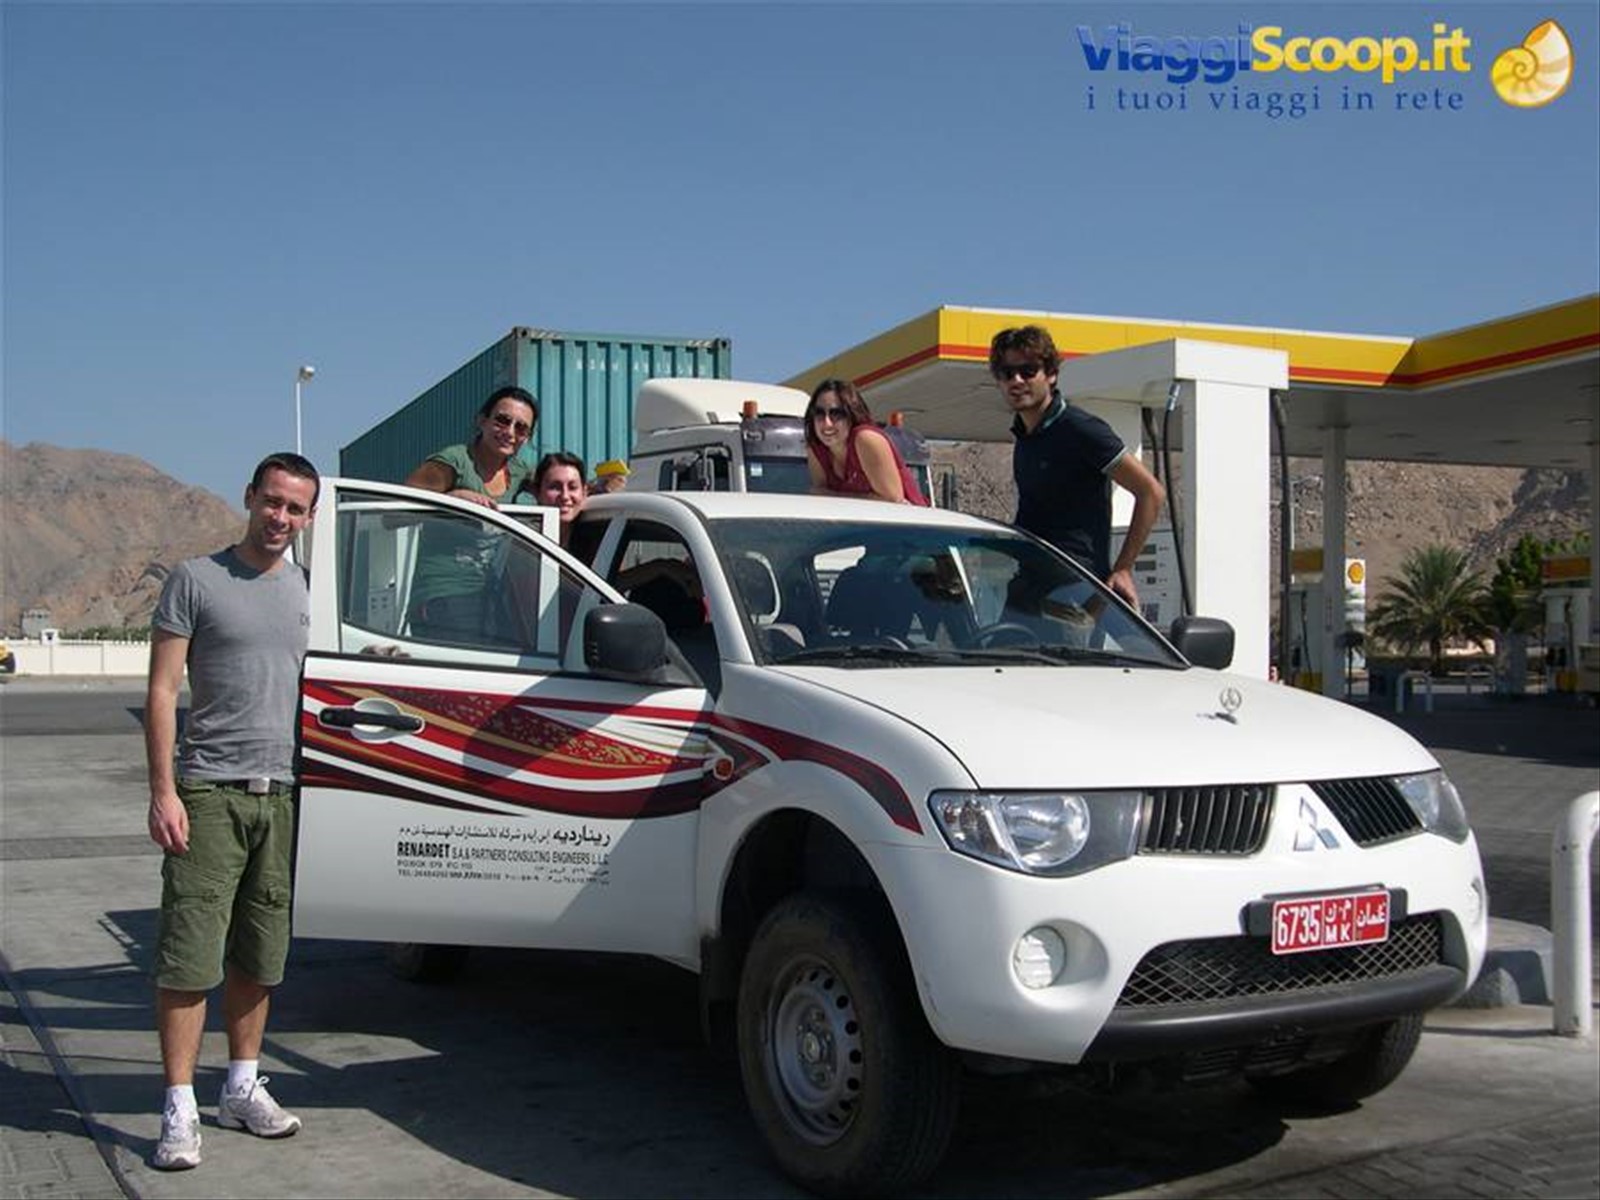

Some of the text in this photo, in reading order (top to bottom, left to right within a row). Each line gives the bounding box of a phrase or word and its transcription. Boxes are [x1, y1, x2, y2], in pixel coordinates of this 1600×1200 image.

[397, 841, 450, 858] RENARDET
[471, 848, 507, 861] PARTNERS
[508, 850, 549, 863] CONSULTING
[552, 851, 590, 865] ENGINEERS
[1277, 905, 1320, 946] 6735
